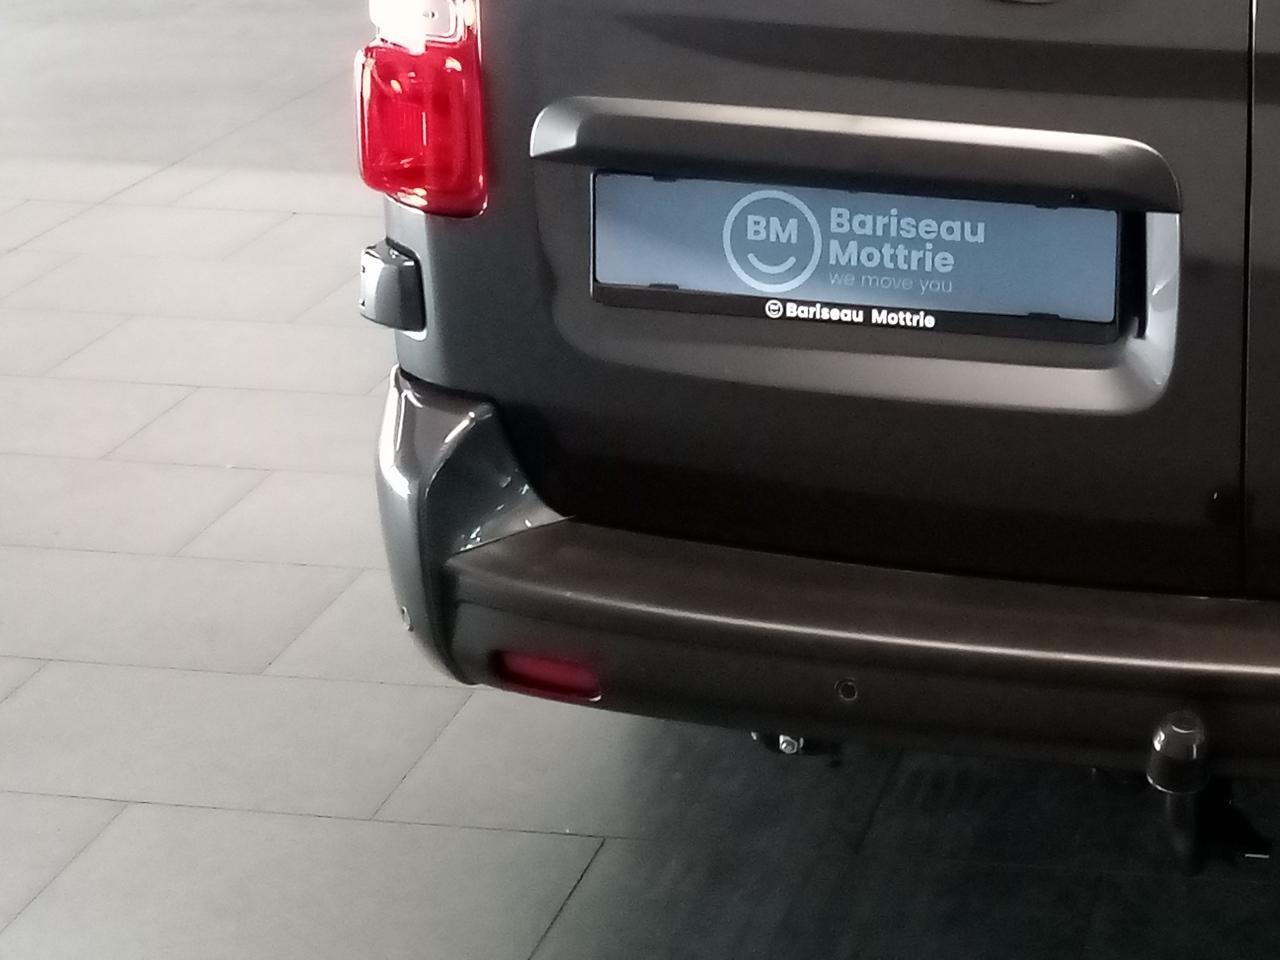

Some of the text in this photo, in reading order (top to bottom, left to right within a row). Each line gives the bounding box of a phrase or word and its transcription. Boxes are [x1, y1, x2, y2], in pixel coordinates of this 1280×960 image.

[746, 214, 799, 244] BM
[829, 207, 985, 243] Bariseau
[828, 239, 955, 274] Mottrie
[828, 271, 953, 296] we move you
[785, 302, 864, 323] Bariseau
[871, 309, 936, 328] Mottrie
